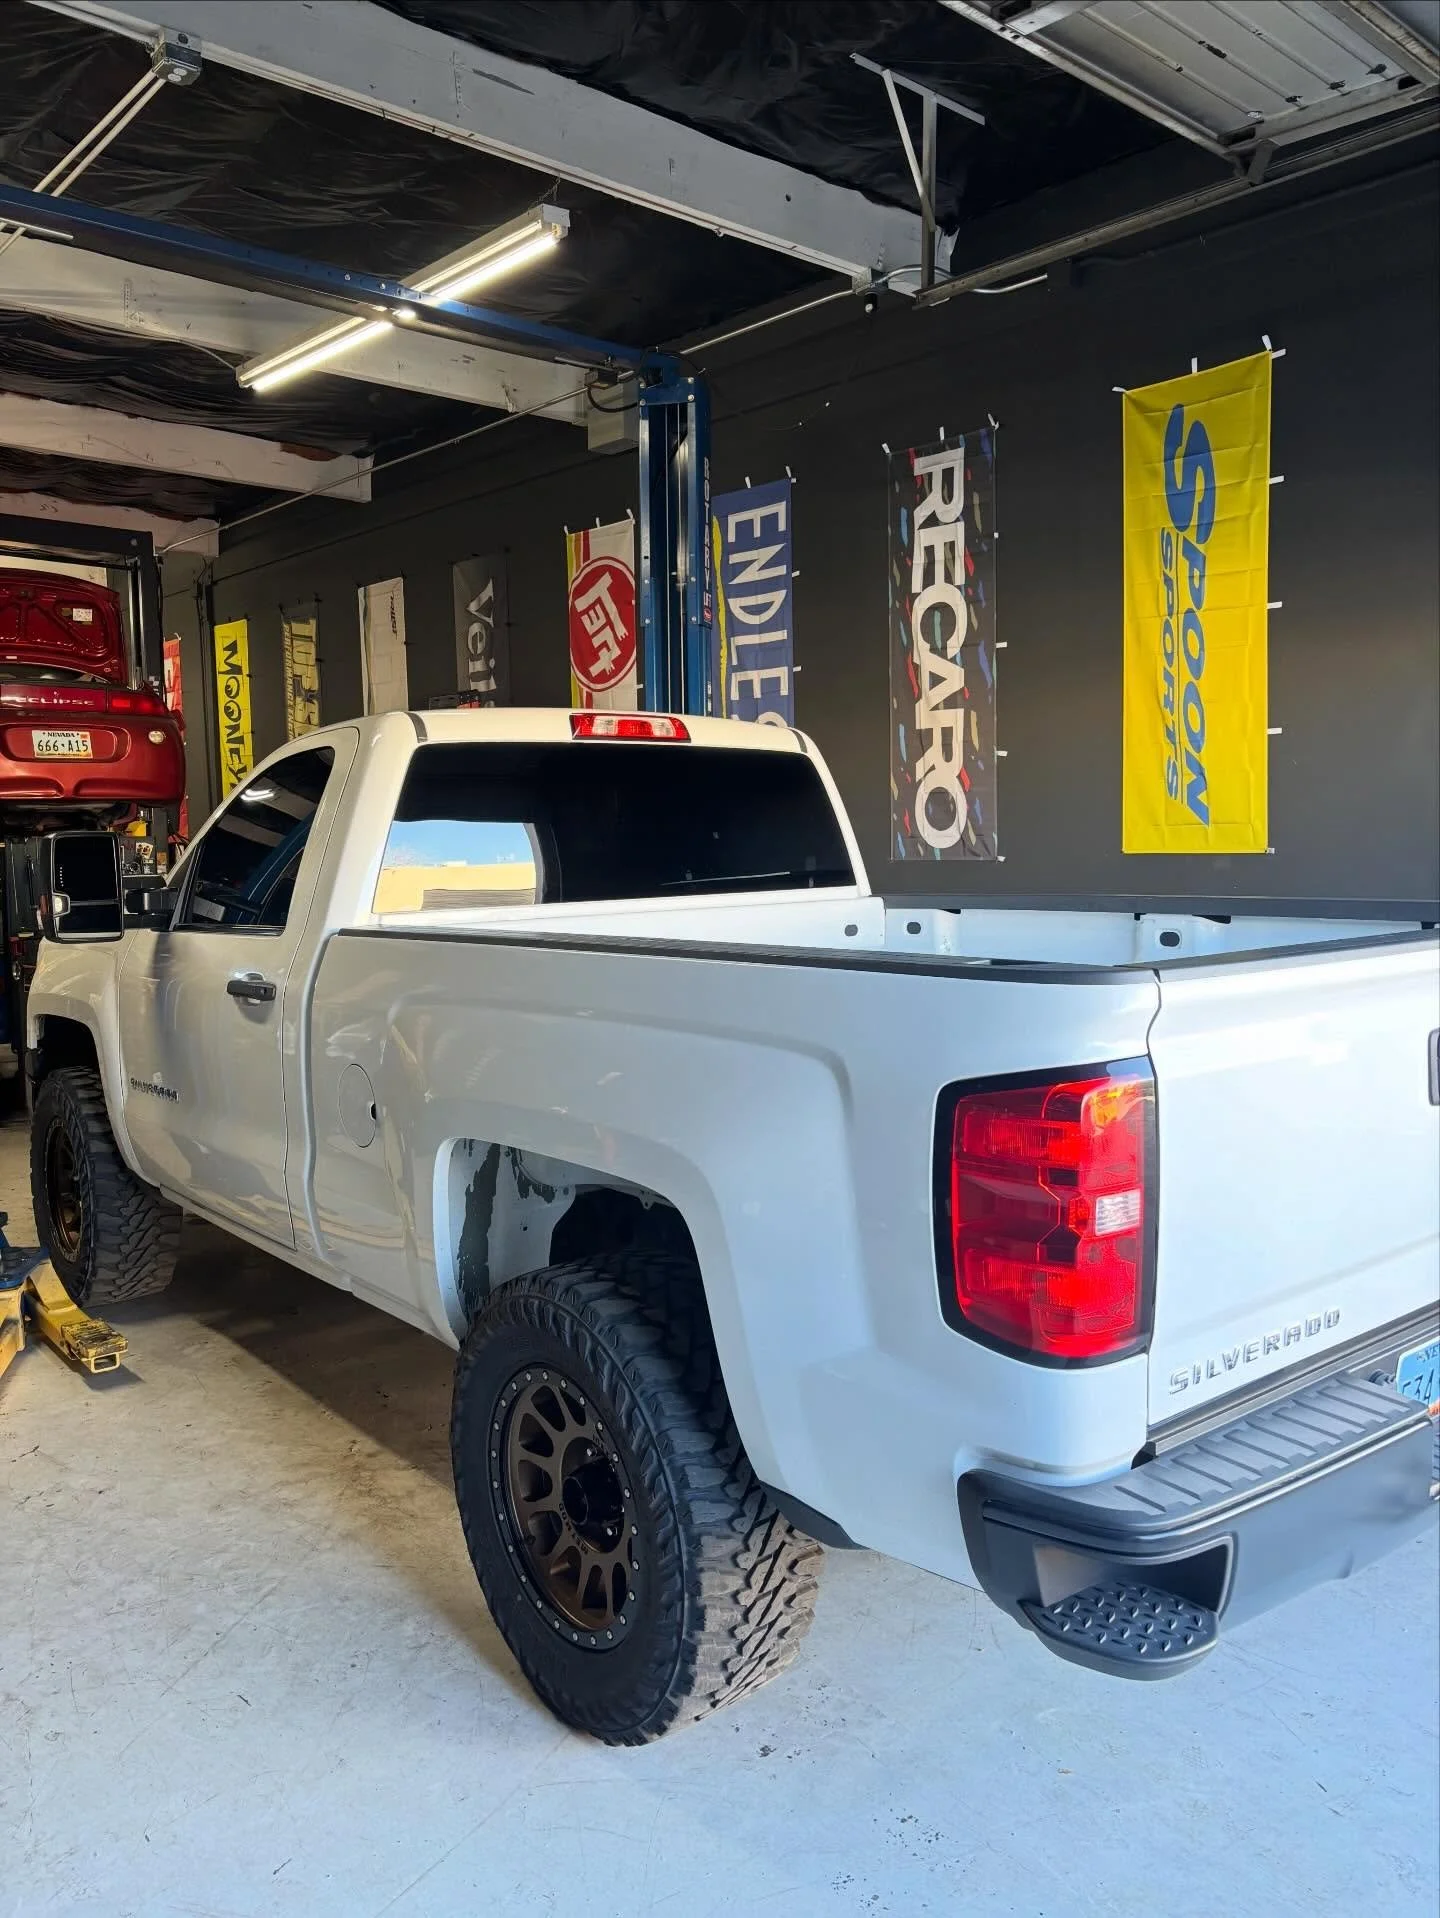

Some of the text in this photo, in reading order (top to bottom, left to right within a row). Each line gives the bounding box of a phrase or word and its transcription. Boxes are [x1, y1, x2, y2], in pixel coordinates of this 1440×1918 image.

[703, 456, 711, 590] ROTARY
[466, 578, 497, 708] Veil
[911, 446, 968, 849] RECARO
[1160, 526, 1178, 800] SPORTS
[1163, 403, 1216, 828] SPOON
[16, 696, 95, 706] ECLIPSE
[1169, 1308, 1341, 1395] SILVERADO
